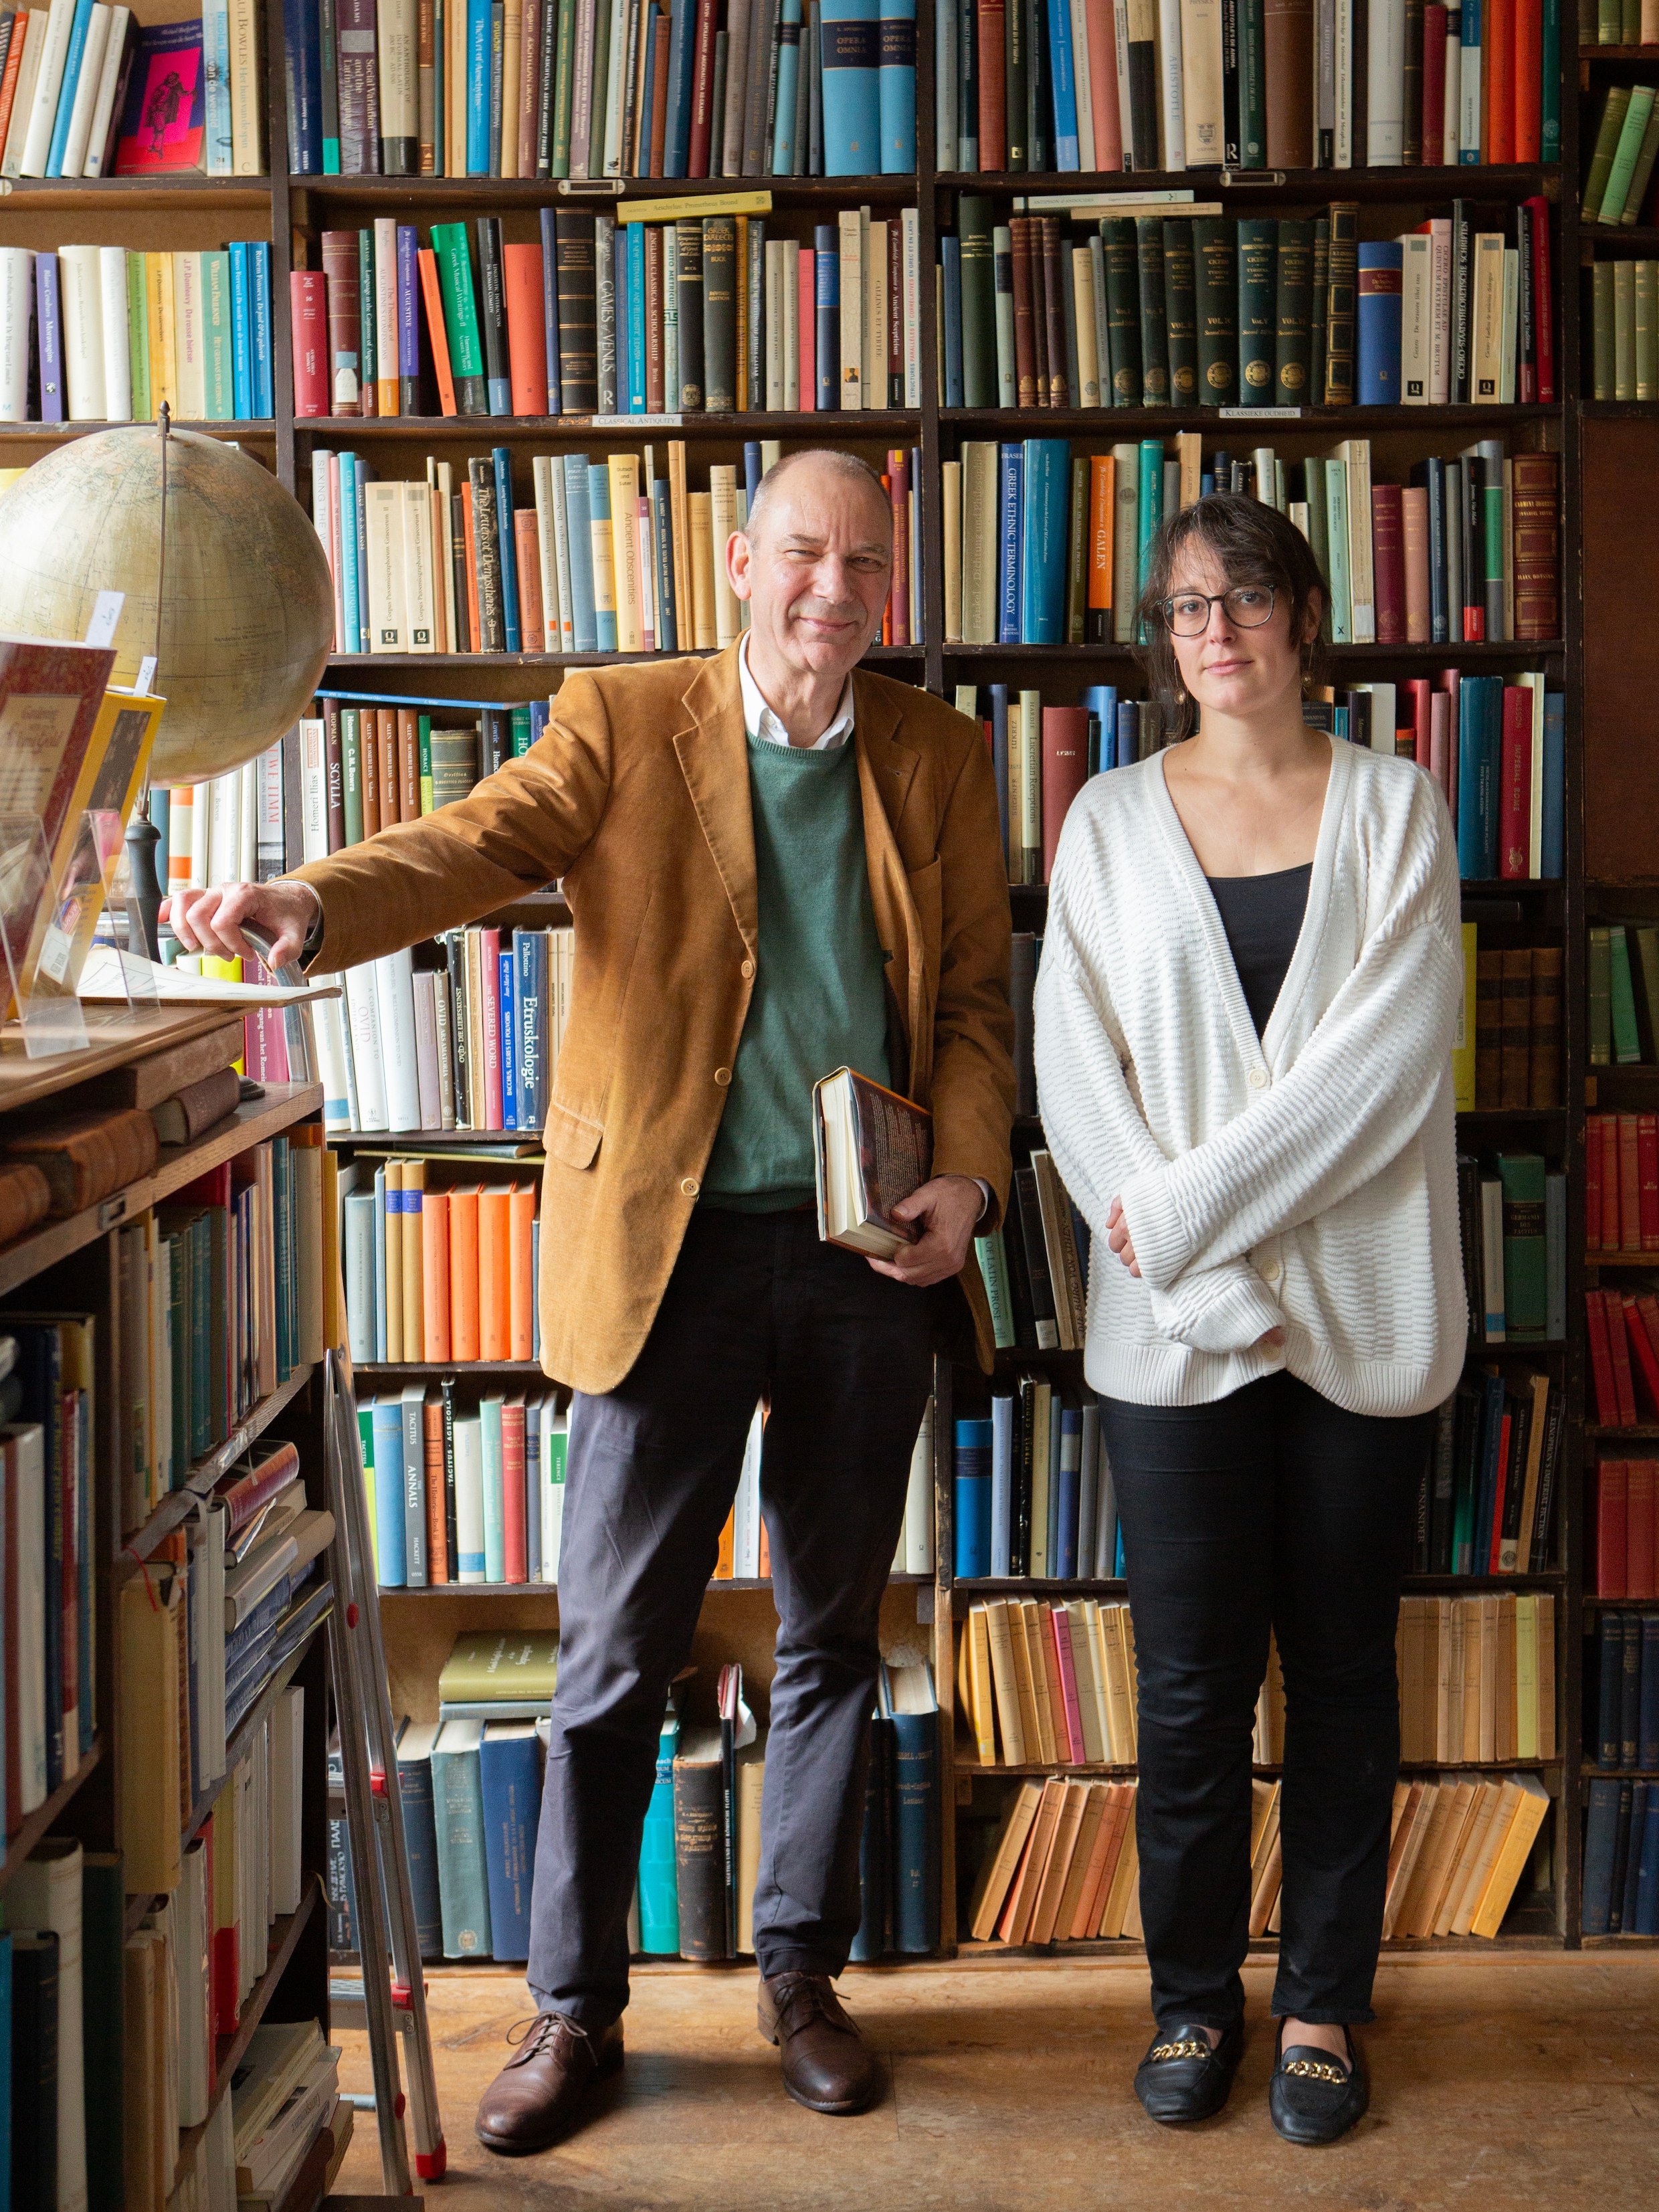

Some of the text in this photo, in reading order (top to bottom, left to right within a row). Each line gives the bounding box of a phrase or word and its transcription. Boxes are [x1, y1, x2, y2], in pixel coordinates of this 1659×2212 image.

[217, 12, 226, 46] Nicolas
[237, 19, 250, 65] BOWLES
[476, 20, 484, 34] The
[476, 36, 484, 52] Art
[343, 59, 353, 83] Latin
[355, 59, 364, 93] and the
[1169, 56, 1180, 121] ARISTOTLE
[209, 94, 219, 128] wereld
[367, 59, 375, 129] Social Variation
[185, 309, 193, 318] De
[387, 302, 395, 332] Theology
[601, 280, 614, 322] GAMES
[876, 318, 882, 328] ET
[892, 320, 900, 355] Scepticism
[1434, 320, 1441, 330] ET
[1442, 321, 1448, 331] AD
[45, 320, 54, 363] Moravagine
[186, 340, 194, 363] bietser
[602, 334, 615, 372] VENUS
[316, 460, 325, 502] SEXING
[318, 507, 326, 529] THE
[348, 545, 355, 554] IN
[479, 488, 496, 616] The Letters of Demosthenes
[623, 513, 636, 605] Ancient Obscenities
[1007, 468, 1017, 614] GREEK ETHNIC TERMINOLOGY
[1096, 530, 1105, 569] GALEN
[1029, 737, 1038, 776] Lucretian
[1514, 744, 1522, 781] IMPERIAL
[310, 775, 319, 832] Homeri Ilias
[330, 763, 340, 809] SCYLLA
[1028, 777, 1038, 824] Receptions
[268, 786, 280, 823] TIMM
[358, 1006, 371, 1042] OVID
[369, 996, 378, 1045] COMPANION
[437, 1000, 446, 1026] OVID
[487, 996, 496, 1036] SEVERED
[521, 942, 539, 1089] Pallottino Etruskologie
[373, 1049, 379, 1060] TO
[488, 1039, 496, 1068] WORD
[985, 1241, 1001, 1321] OF LATIN PROSE
[409, 1412, 417, 1445] TACITUS
[407, 1465, 417, 1507] ANNALS
[1541, 1469, 1551, 1504] IMPERIAL
[1537, 1506, 1547, 1539] FICTION
